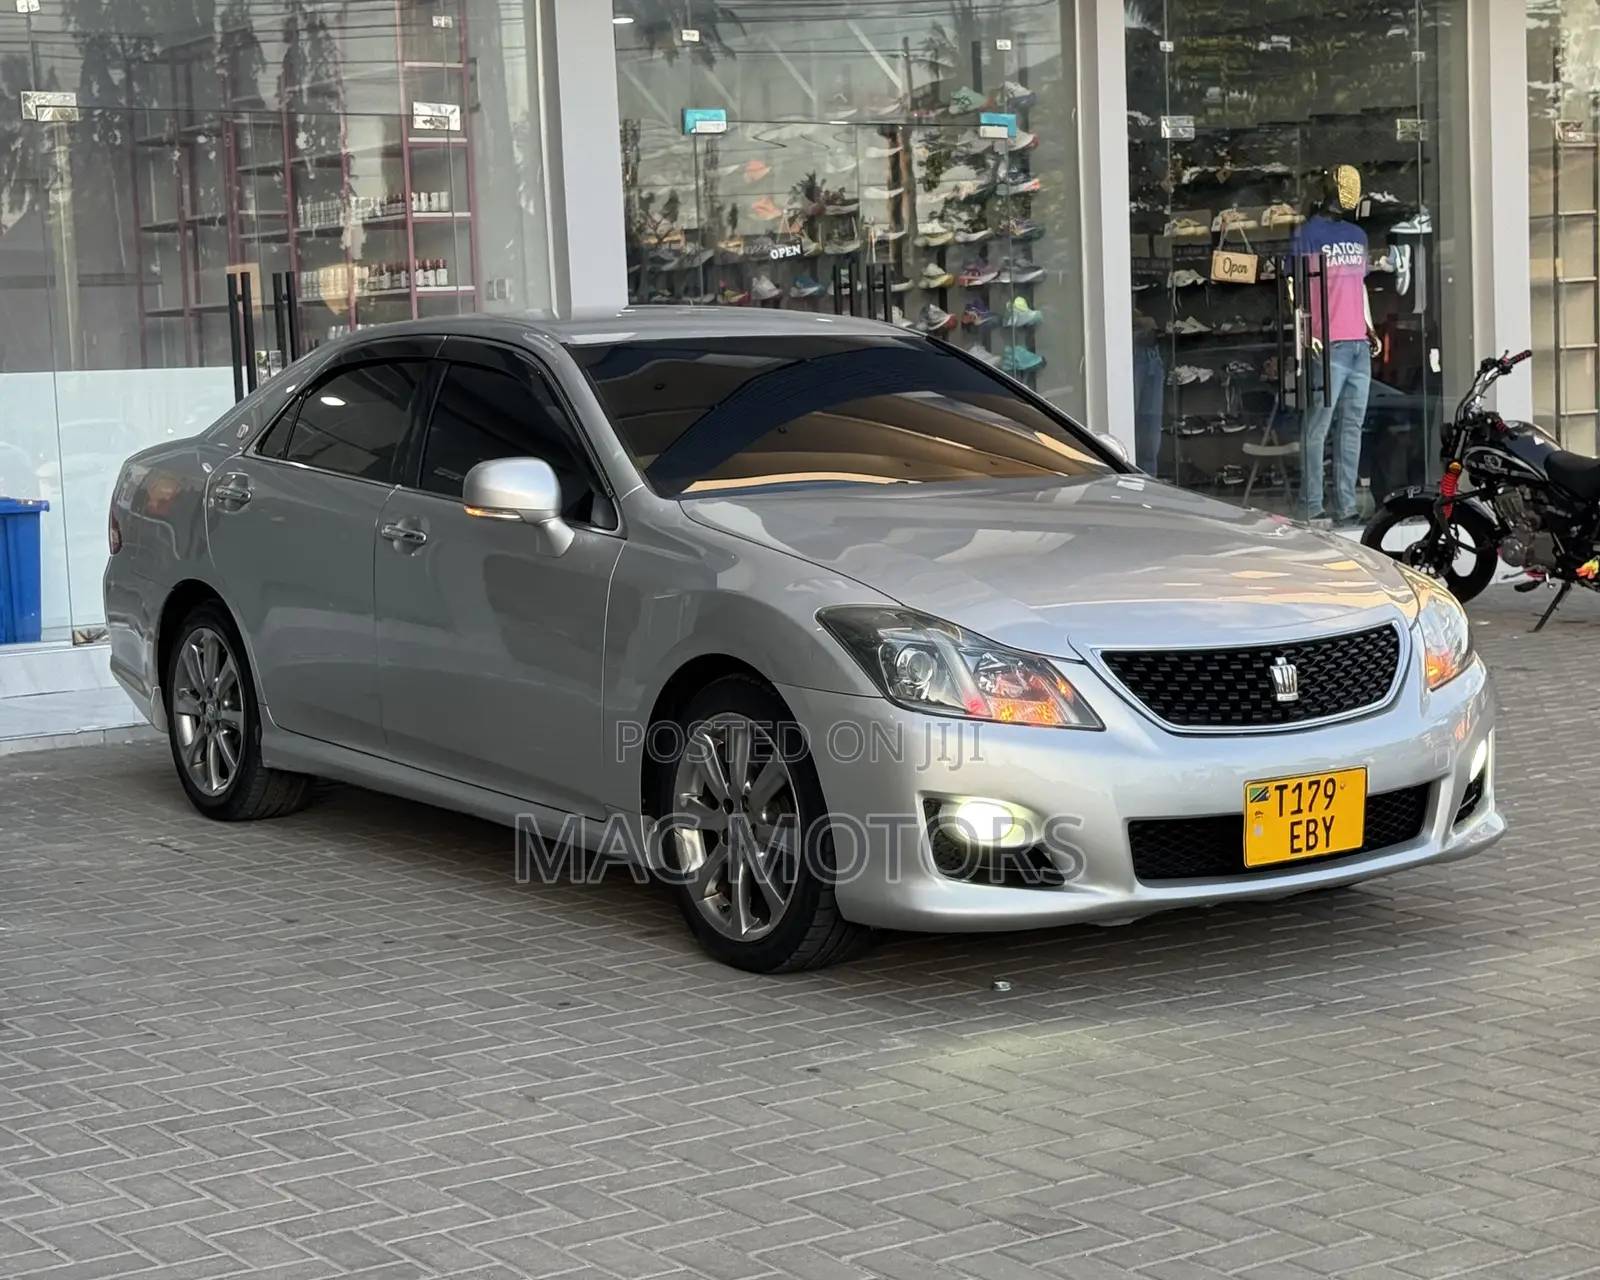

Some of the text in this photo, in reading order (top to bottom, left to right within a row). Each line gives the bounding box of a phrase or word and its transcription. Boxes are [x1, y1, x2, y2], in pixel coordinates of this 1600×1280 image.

[770, 244, 801, 260] OPEN
[1222, 256, 1248, 278] Open
[1274, 777, 1337, 818] T179
[1289, 815, 1336, 855] EBY
